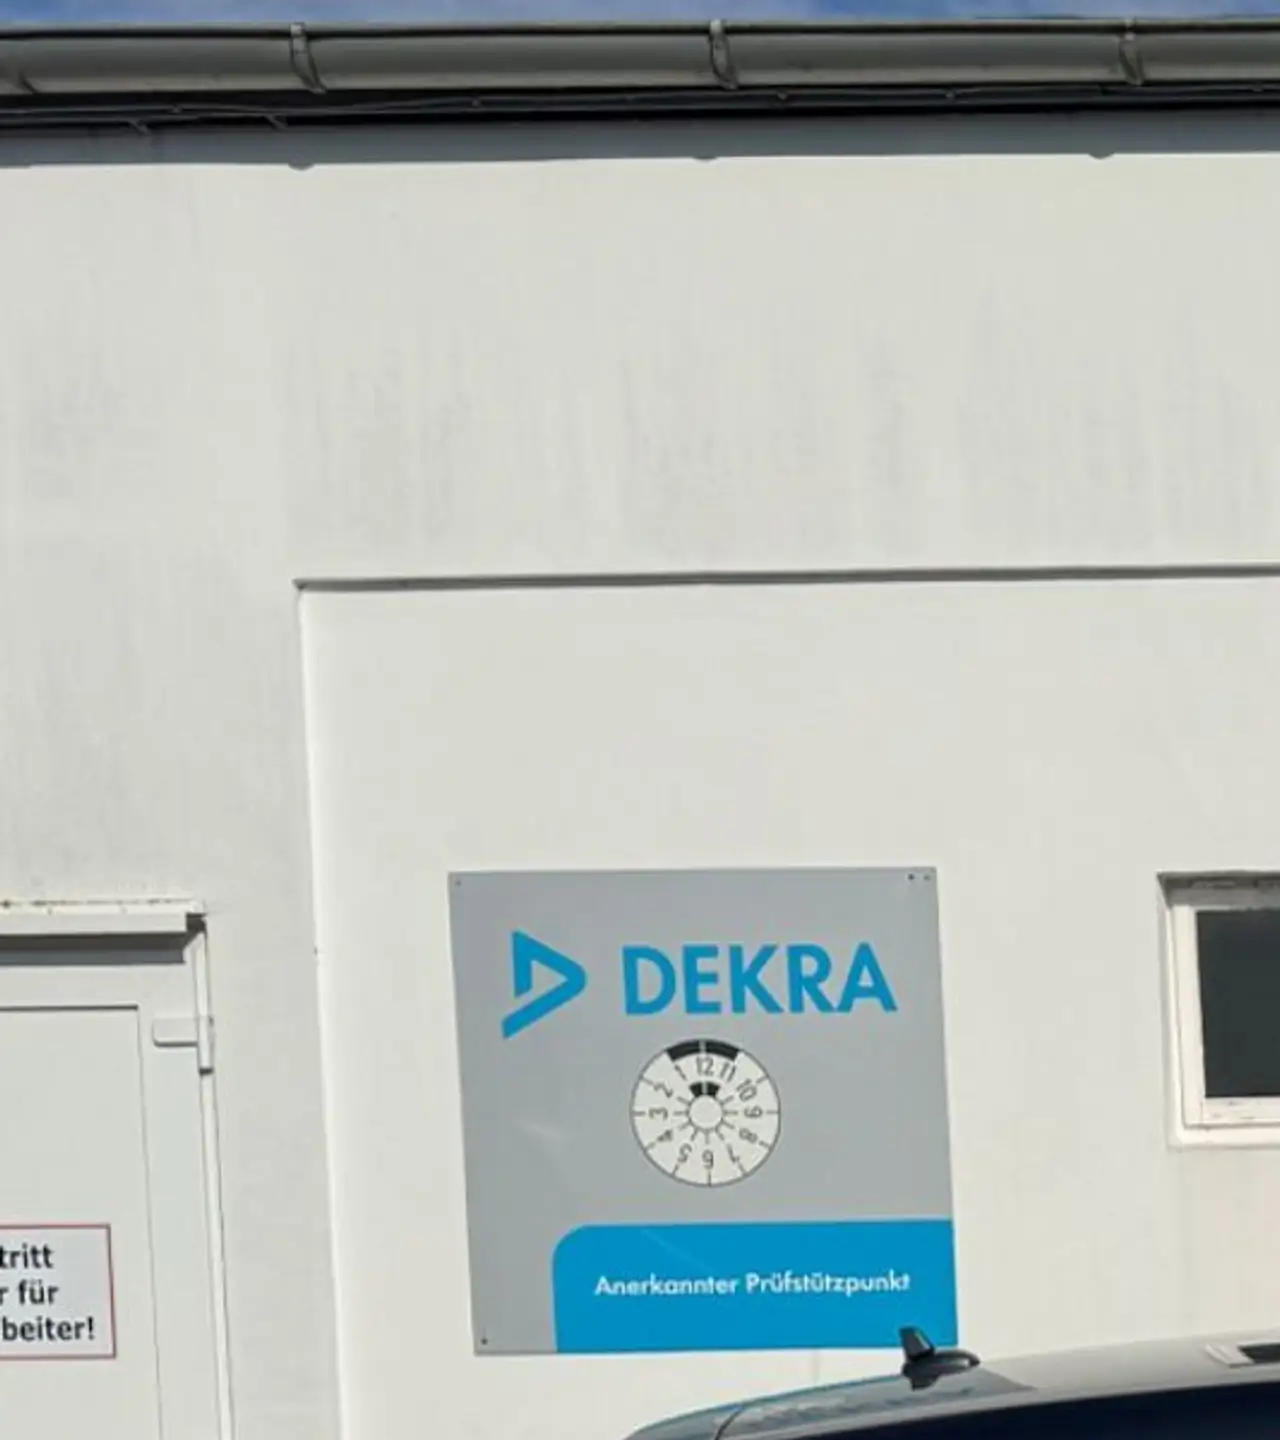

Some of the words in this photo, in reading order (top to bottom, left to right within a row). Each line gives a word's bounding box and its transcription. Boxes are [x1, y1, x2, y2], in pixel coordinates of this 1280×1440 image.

[622, 942, 898, 1016] DEKRA
[696, 1056, 714, 1076] 12
[720, 1061, 736, 1082] 11
[654, 1083, 673, 1099] 2
[736, 1078, 757, 1102] 10
[648, 1107, 668, 1120] 3
[739, 1128, 758, 1143] 8
[677, 1143, 692, 1163] 5
[19, 1279, 59, 1305] für
[594, 1272, 739, 1295] Anerkannter
[746, 1269, 910, 1297] Prüfstützpunkt
[2, 1316, 96, 1341] beiter!
